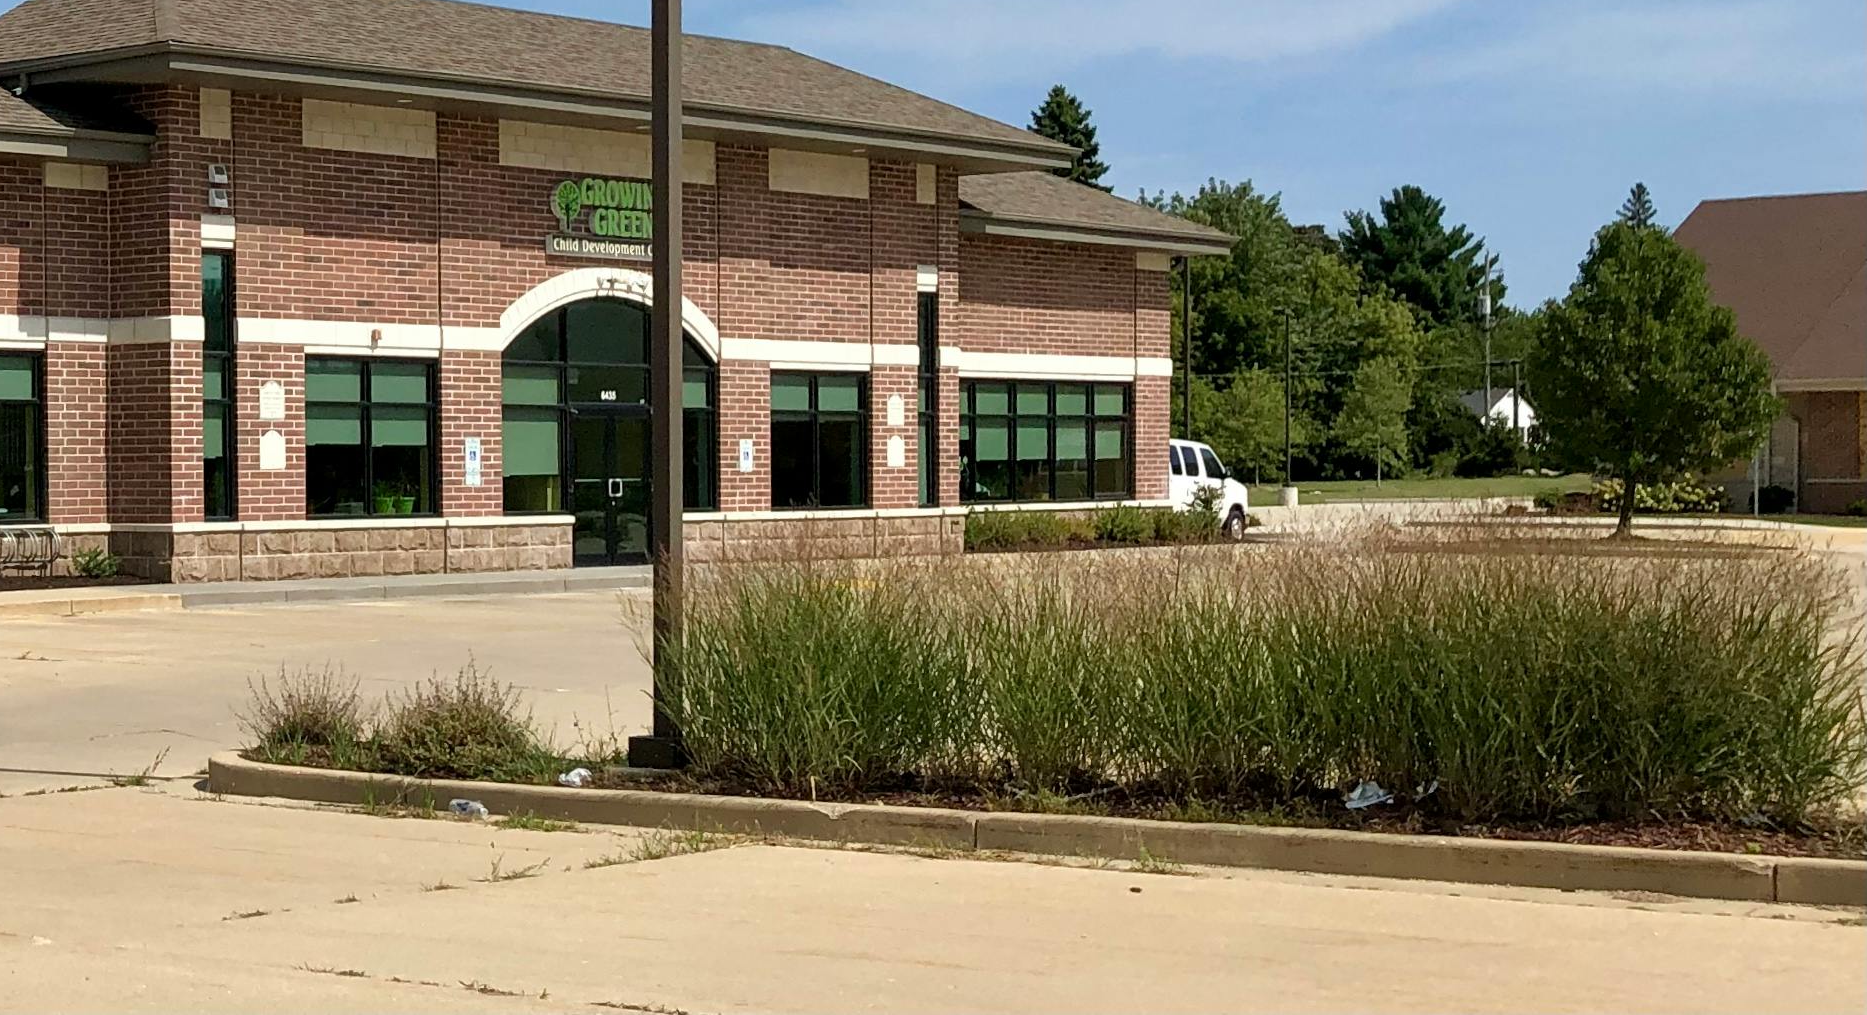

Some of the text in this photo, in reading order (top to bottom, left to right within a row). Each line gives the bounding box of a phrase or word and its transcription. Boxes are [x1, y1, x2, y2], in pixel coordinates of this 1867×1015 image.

[581, 177, 652, 209] GROWIN
[595, 208, 652, 239] GREEN
[553, 237, 579, 252] Child
[582, 239, 645, 257] Development
